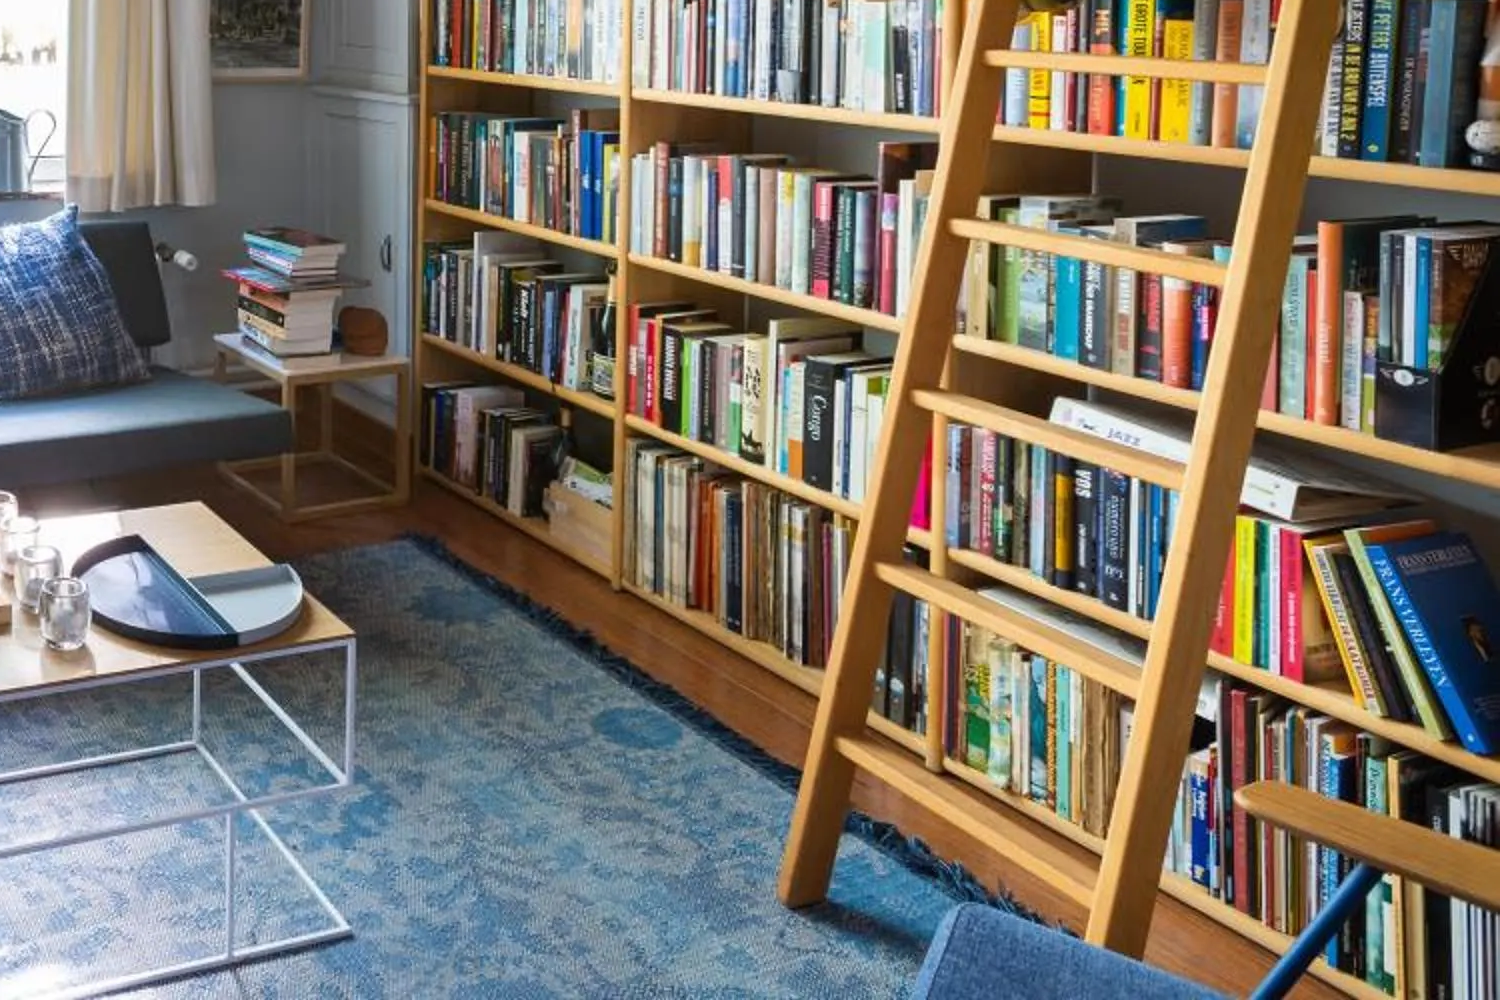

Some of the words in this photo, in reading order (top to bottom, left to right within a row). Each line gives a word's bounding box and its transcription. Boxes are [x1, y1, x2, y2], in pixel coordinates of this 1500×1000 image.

[808, 395, 827, 441] Congo
[1372, 558, 1410, 609] FRANS
[1400, 609, 1452, 688] VERLEYEN
